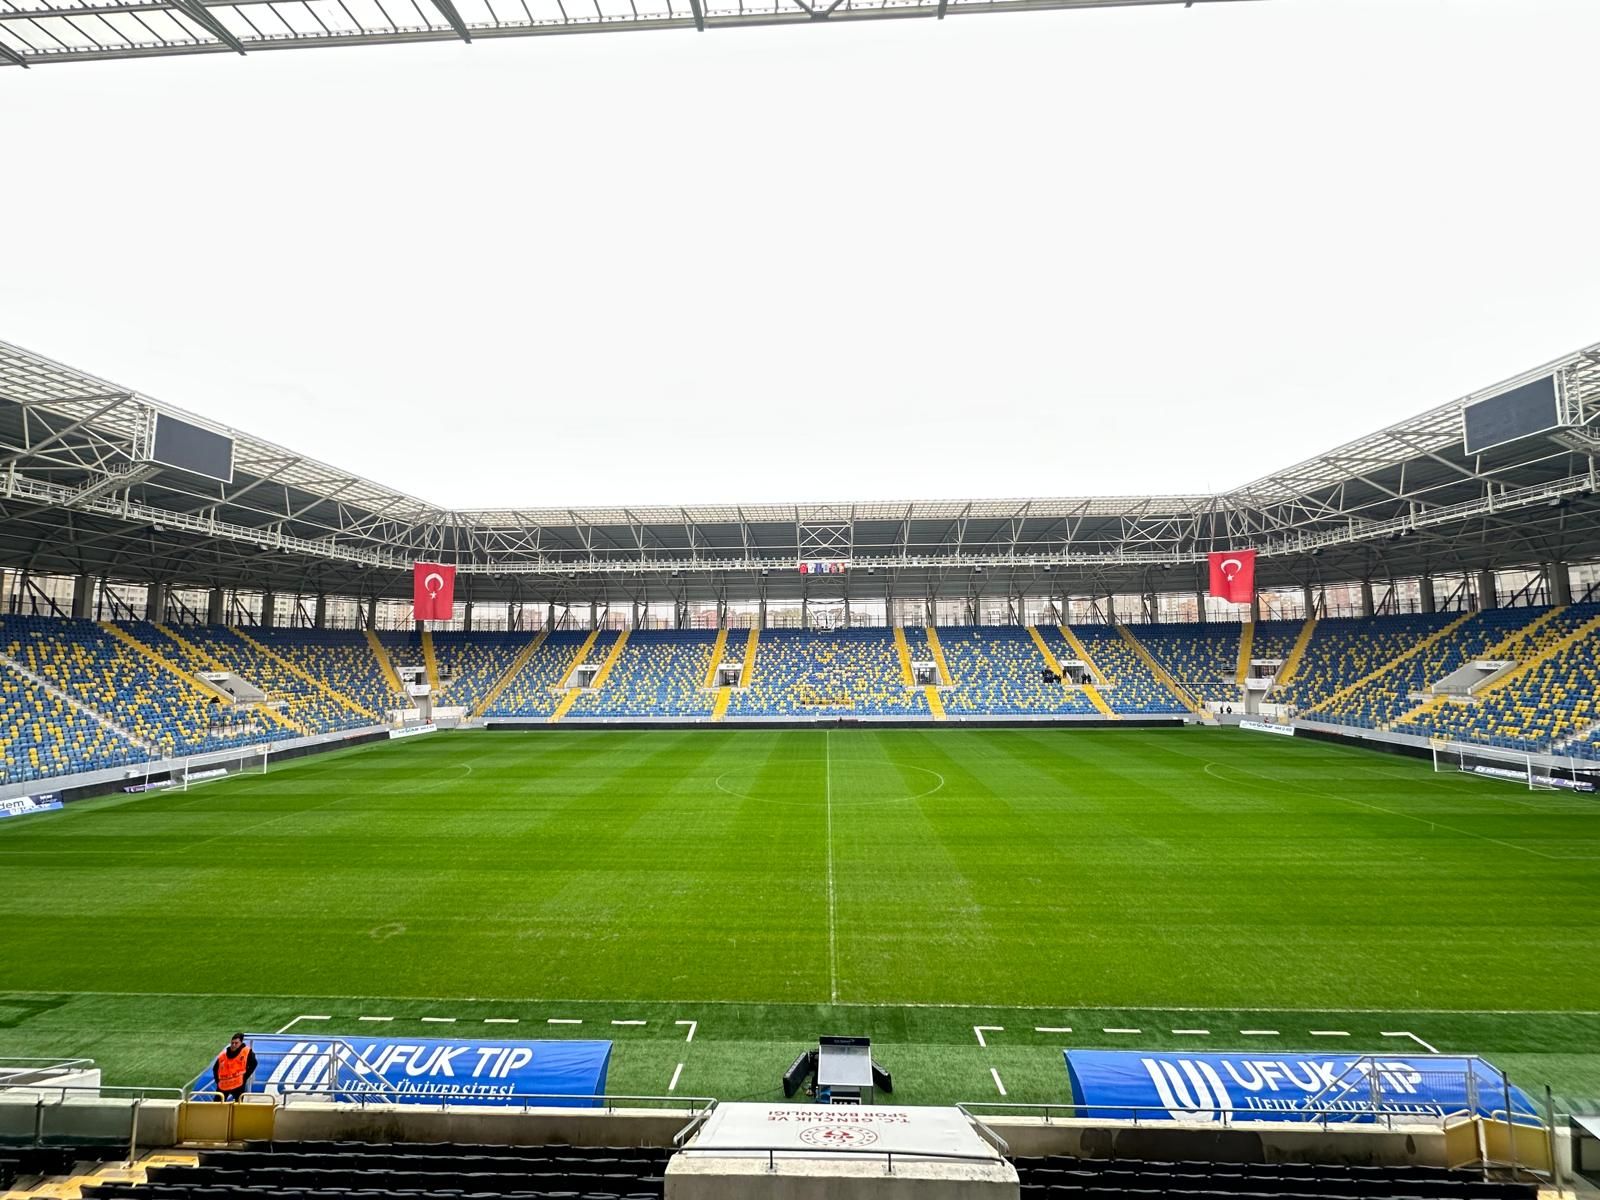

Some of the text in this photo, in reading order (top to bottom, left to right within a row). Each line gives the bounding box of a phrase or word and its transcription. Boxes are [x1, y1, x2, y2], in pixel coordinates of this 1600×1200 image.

[354, 1044, 533, 1078] UFUK TIP
[396, 1078, 515, 1100] ÜNİVERSİTESİ
[1220, 1059, 1422, 1094] UFUK TIP
[796, 1115, 873, 1123] GENÇLİK
